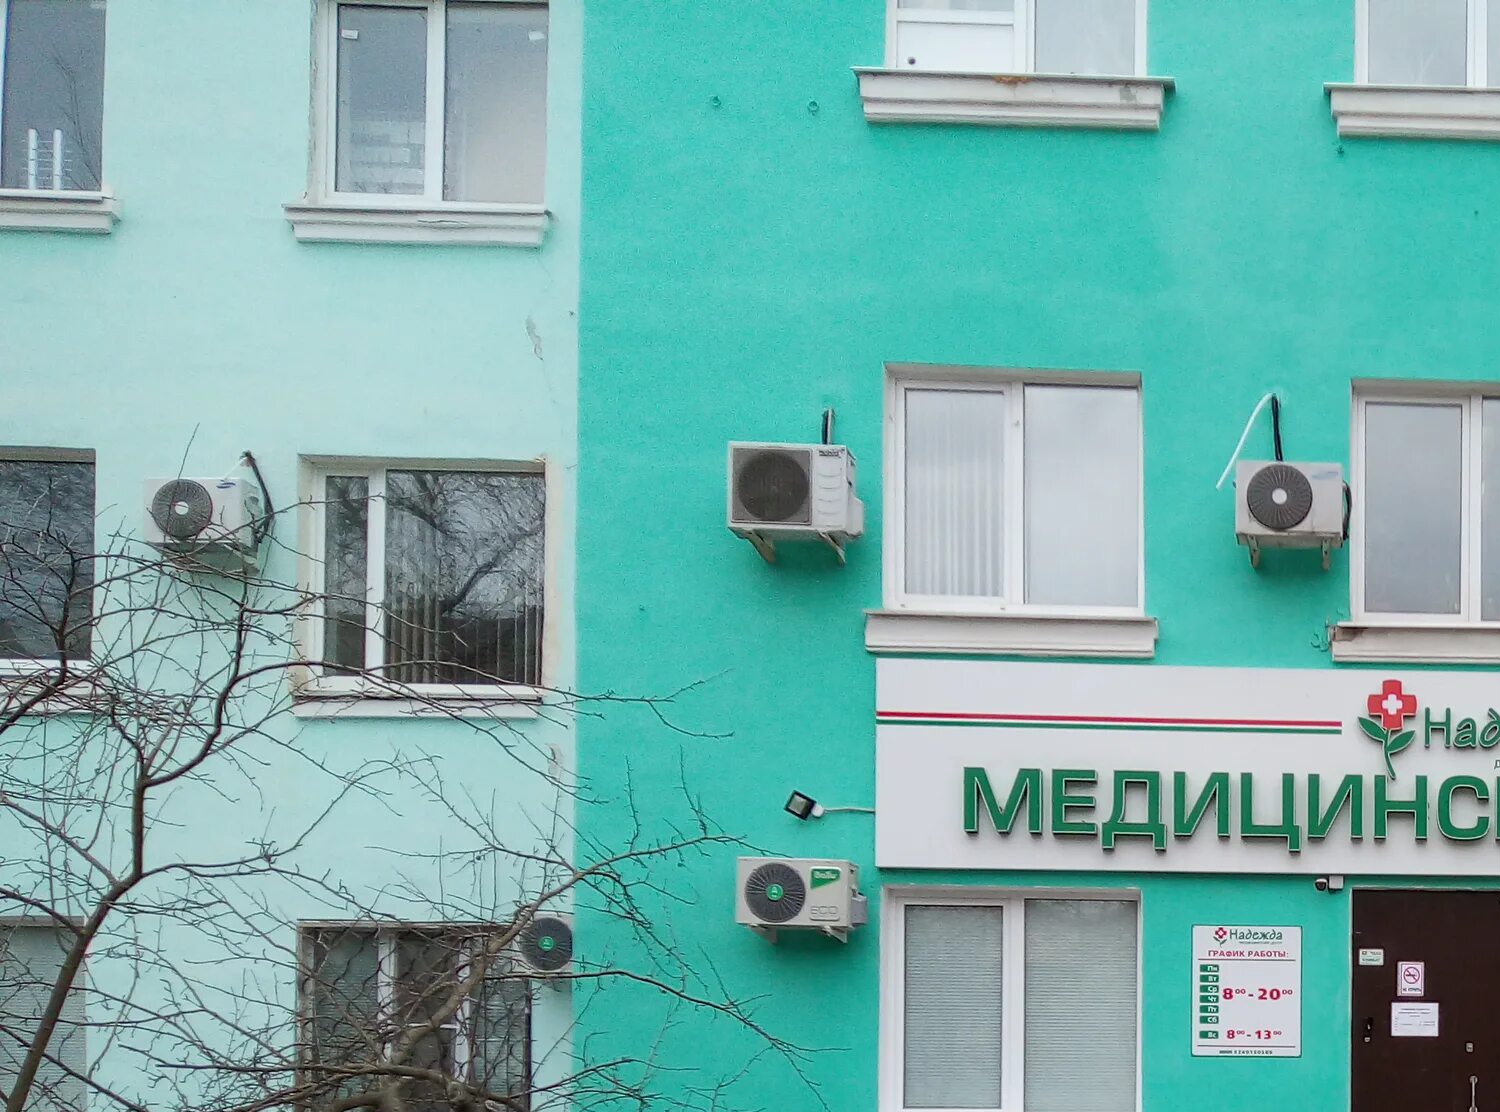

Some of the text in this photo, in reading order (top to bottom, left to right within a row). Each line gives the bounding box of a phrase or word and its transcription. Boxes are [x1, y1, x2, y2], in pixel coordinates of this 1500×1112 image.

[1229, 928, 1283, 940] Надежда
[1208, 949, 1289, 958] ГРАФИК РАБОТЫ:
